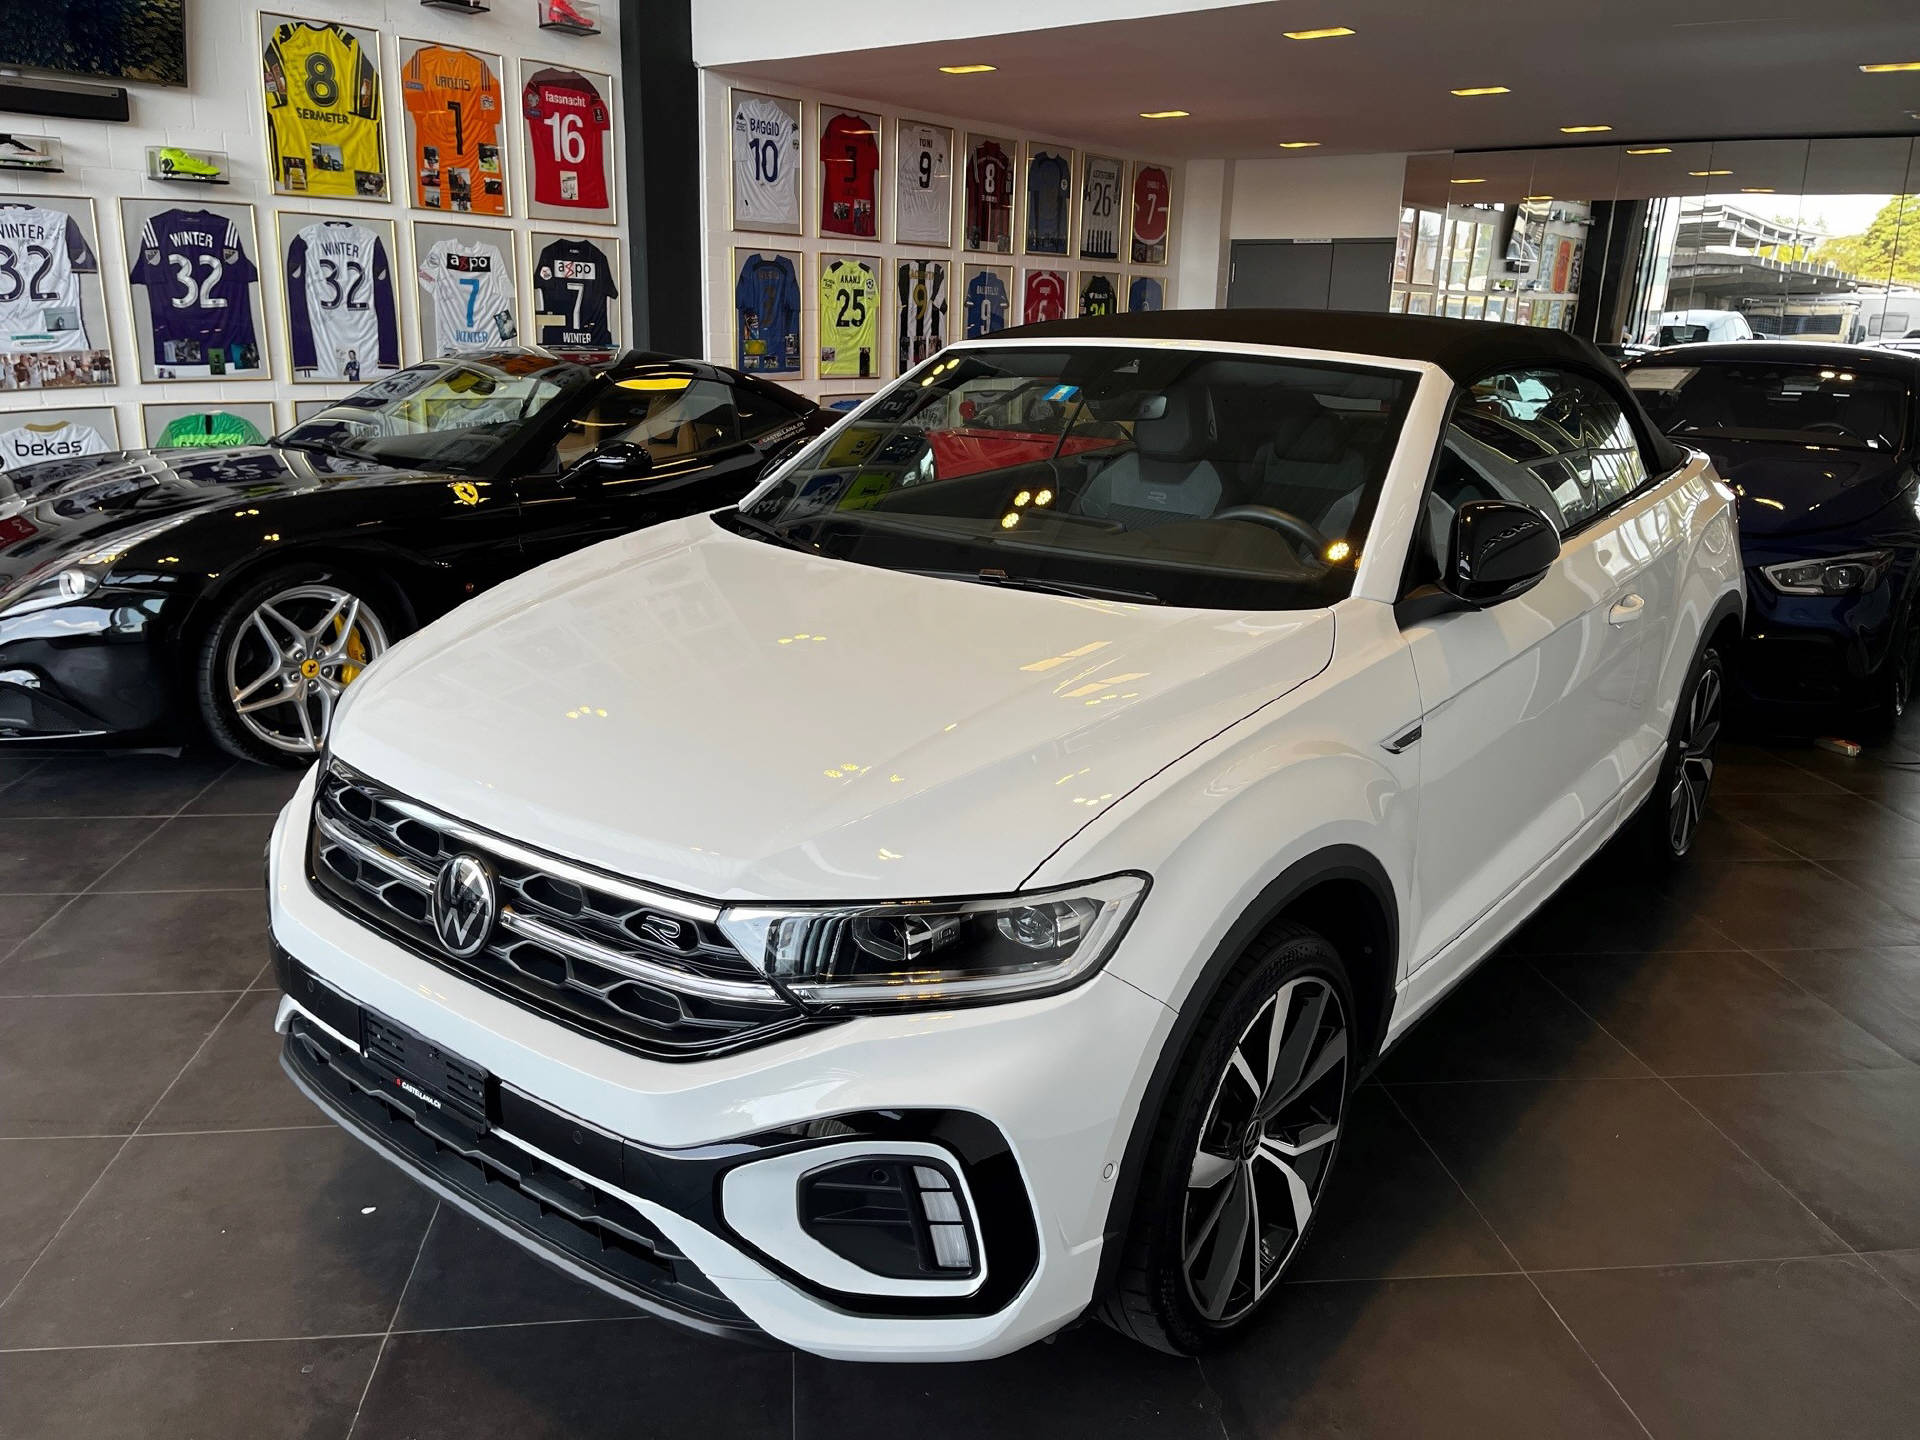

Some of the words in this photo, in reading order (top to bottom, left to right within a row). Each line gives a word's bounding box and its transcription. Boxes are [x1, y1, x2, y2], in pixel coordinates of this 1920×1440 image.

[305, 51, 339, 107] 8
[296, 107, 349, 125] SERMETER
[545, 91, 586, 107] fassnacht
[447, 101, 463, 155] 1
[543, 111, 586, 164] 16
[750, 118, 780, 136] BAGGIO
[748, 138, 778, 182] 10
[919, 151, 932, 188] 9
[984, 163, 996, 193] 8
[1092, 182, 1112, 217] 26
[1147, 193, 1157, 225] 7
[169, 231, 213, 248] WINTER
[321, 242, 360, 258] WINTER
[0, 244, 60, 302] 32
[168, 253, 228, 308] 32
[319, 259, 370, 311] 32
[459, 278, 480, 328] 7
[566, 282, 584, 330] 7
[836, 288, 866, 328] 25
[913, 283, 928, 320] 9
[980, 299, 991, 335] 9
[562, 332, 592, 344] WINTER
[14, 439, 82, 457] bekaş
